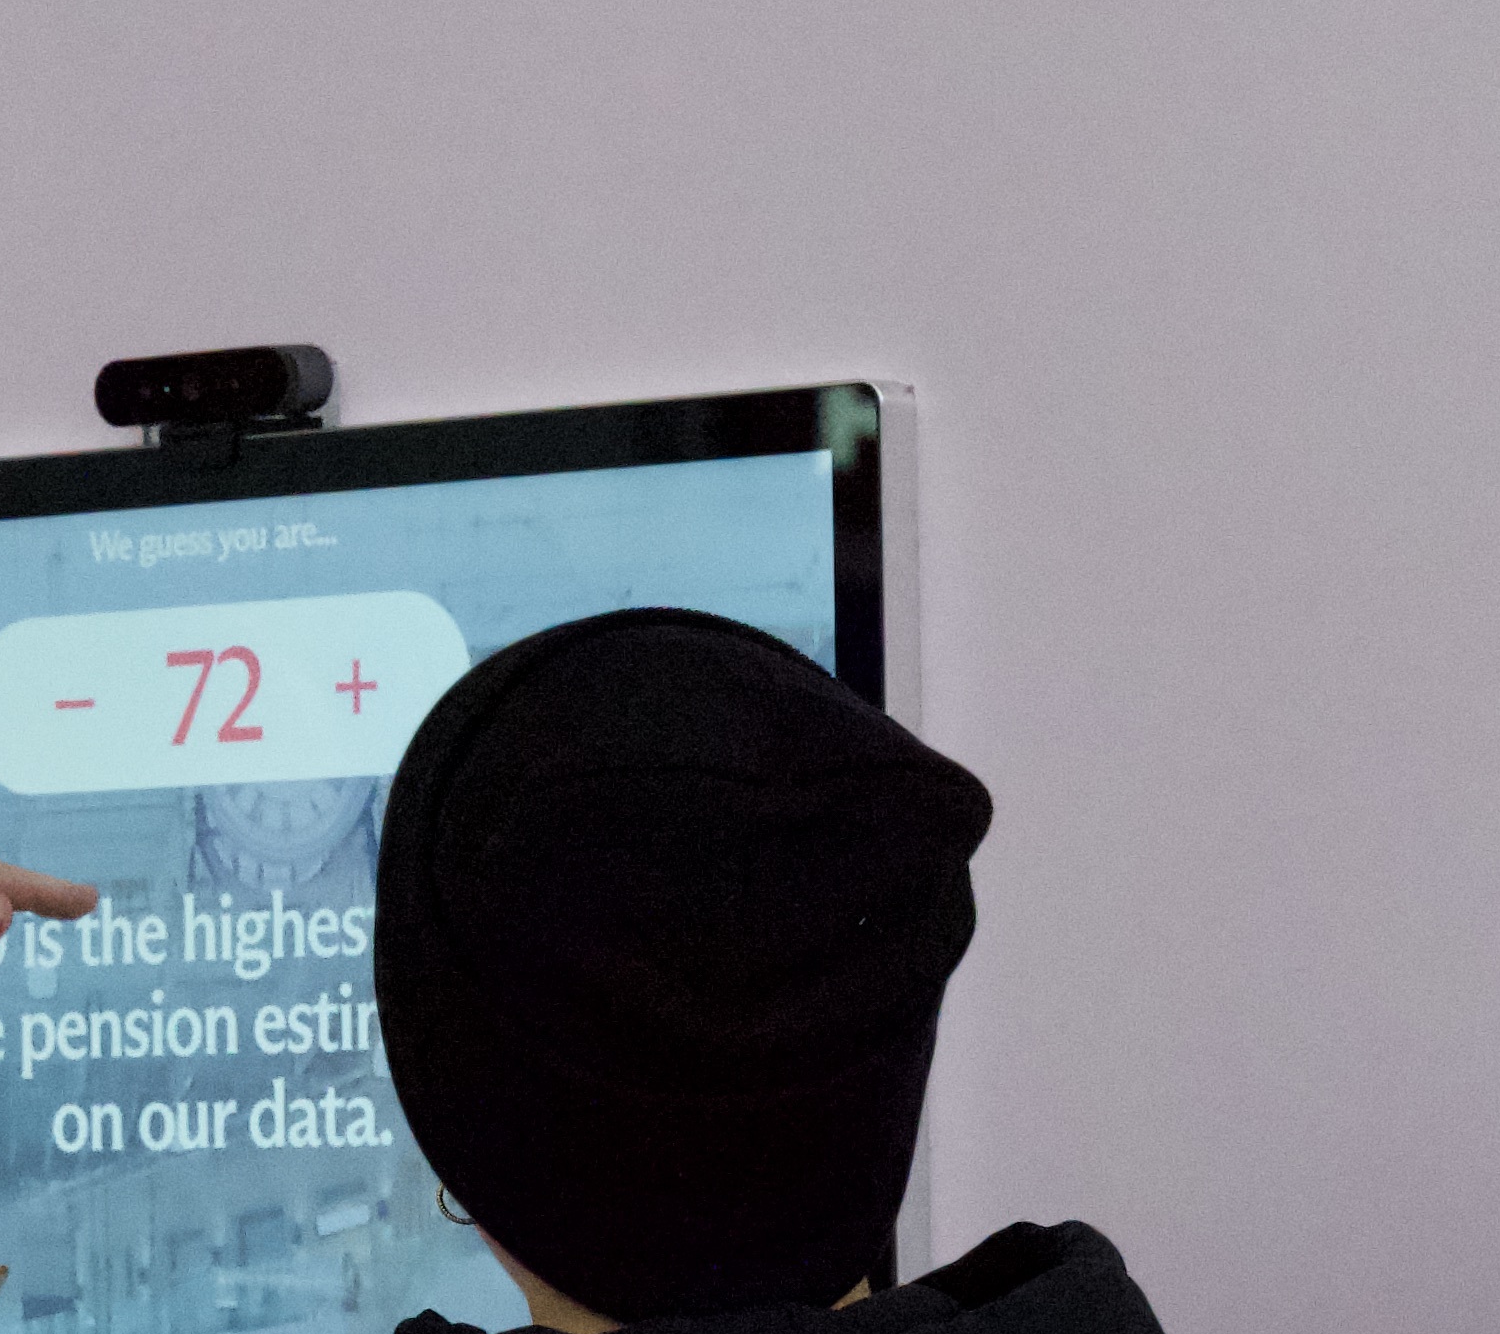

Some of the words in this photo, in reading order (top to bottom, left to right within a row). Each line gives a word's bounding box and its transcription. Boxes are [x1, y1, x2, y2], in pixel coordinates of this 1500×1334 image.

[89, 531, 133, 562] We
[139, 531, 214, 568] guess
[217, 528, 267, 563] you
[166, 645, 263, 746] 72
[23, 910, 65, 969] is
[75, 897, 170, 968] the
[182, 889, 375, 981] highes
[20, 988, 239, 1080] pension
[53, 1101, 123, 1154] on
[138, 1099, 238, 1152] our
[249, 1075, 394, 1149] data.
